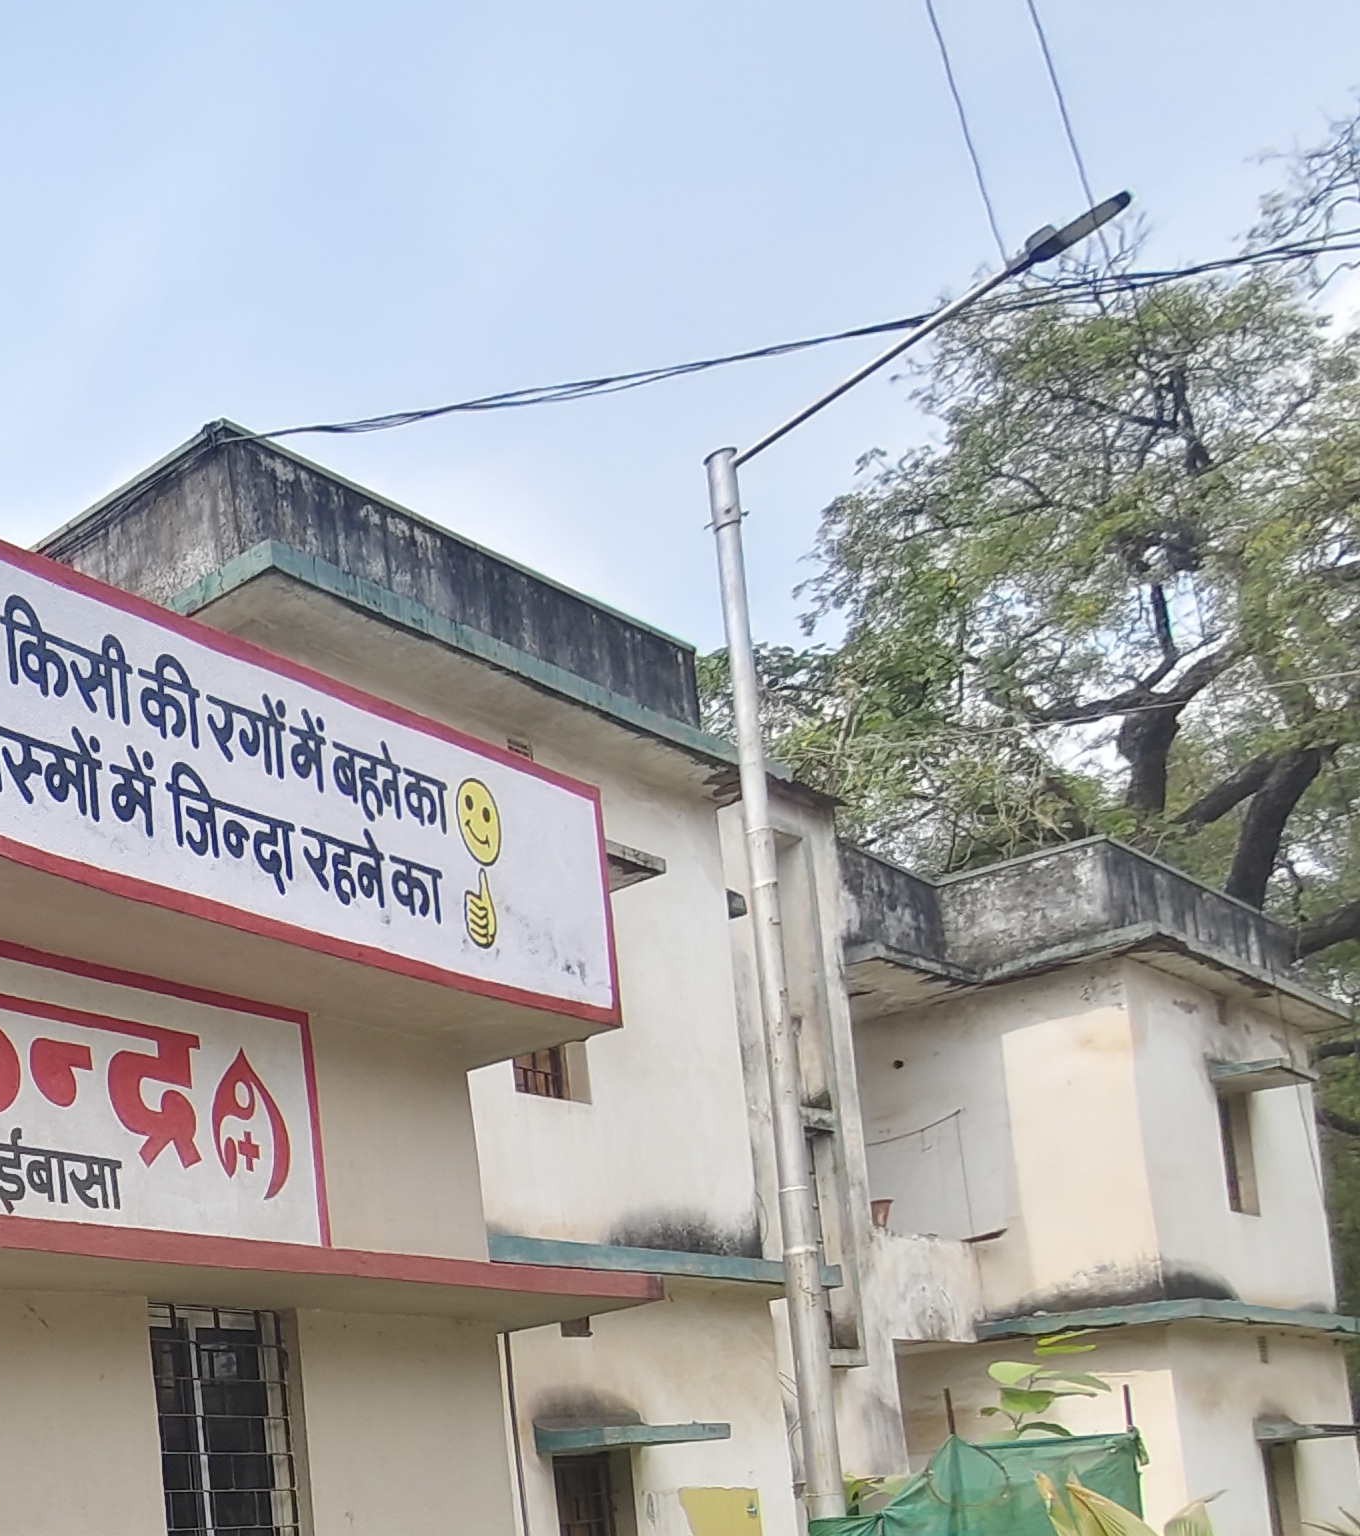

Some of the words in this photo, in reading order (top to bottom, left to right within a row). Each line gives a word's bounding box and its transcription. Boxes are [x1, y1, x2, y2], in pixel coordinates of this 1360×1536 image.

[138, 653, 202, 750] की
[206, 694, 288, 781] रगों
[289, 708, 327, 794] में
[332, 739, 402, 825] बहने
[402, 764, 448, 835] का
[108, 746, 158, 838] में
[163, 759, 296, 897] जिन्दा
[300, 827, 389, 911] रहने
[391, 854, 443, 925] का
